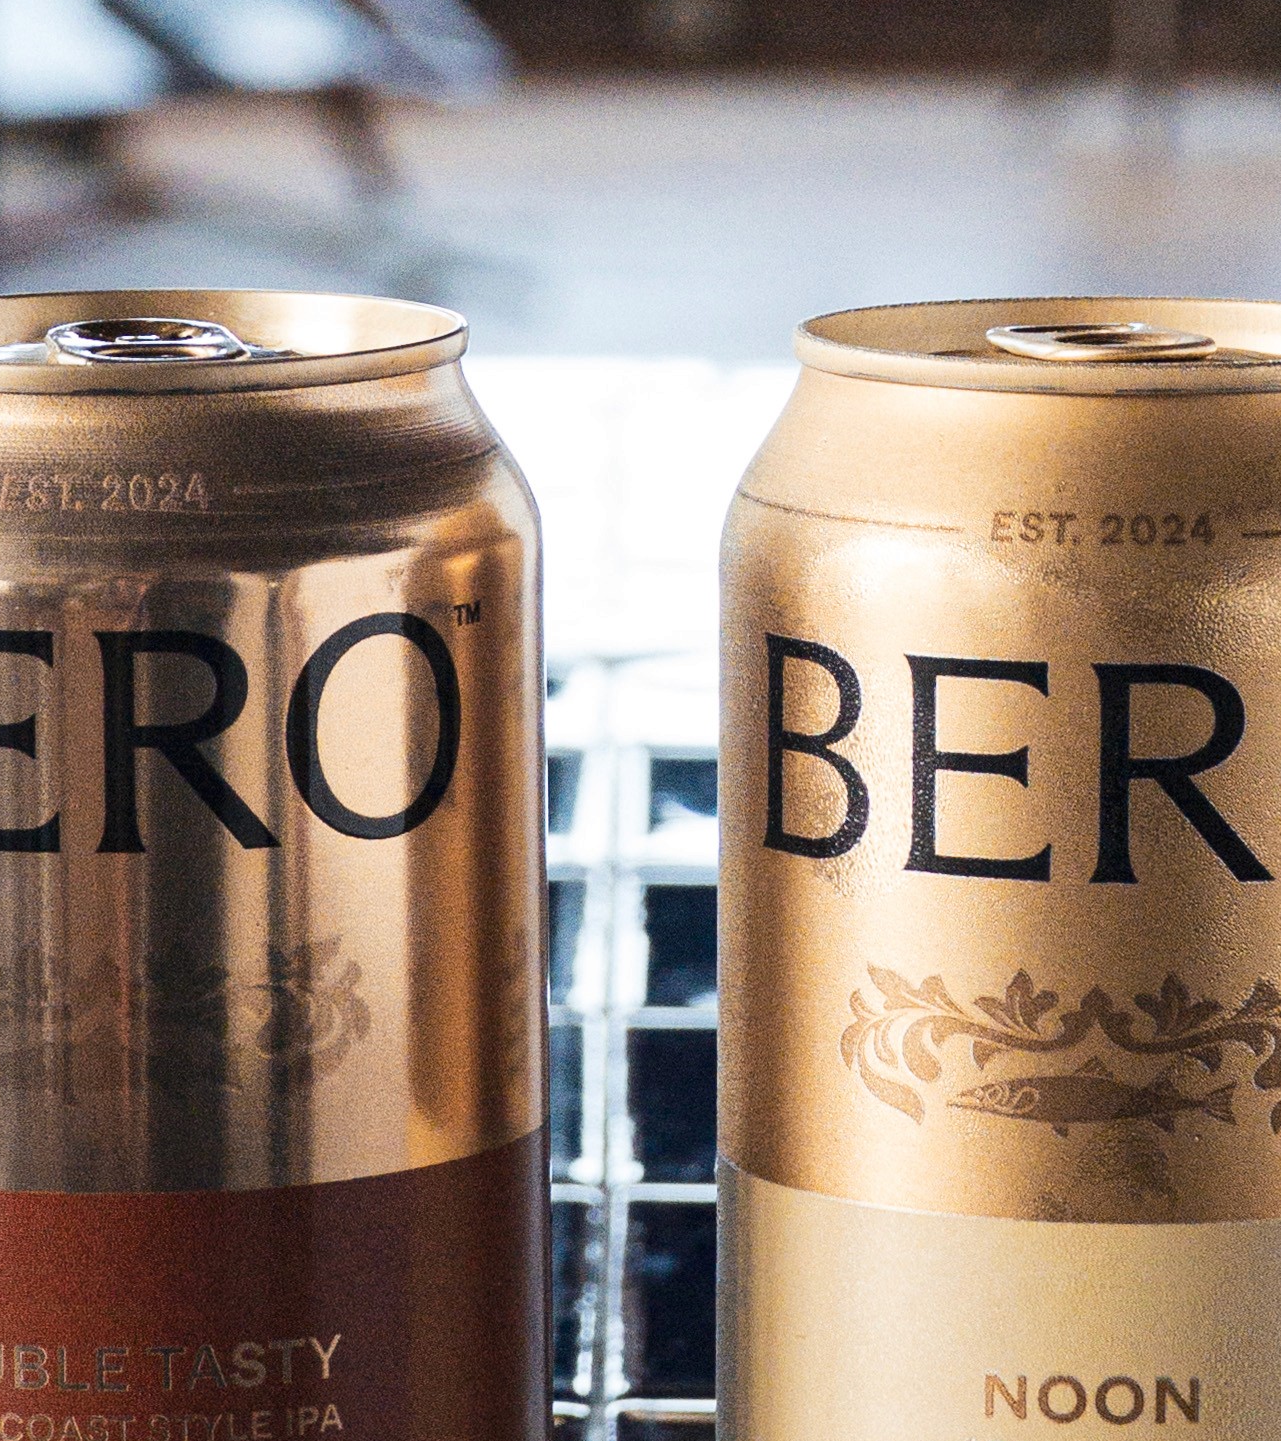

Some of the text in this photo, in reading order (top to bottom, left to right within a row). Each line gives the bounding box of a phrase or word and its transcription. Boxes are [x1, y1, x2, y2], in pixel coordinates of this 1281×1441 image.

[100, 471, 210, 512] 2024
[990, 511, 1218, 546] EST. 2024
[144, 1332, 343, 1390] TASTY
[983, 1370, 1202, 1425] NOON
[283, 1403, 344, 1437] IPA
